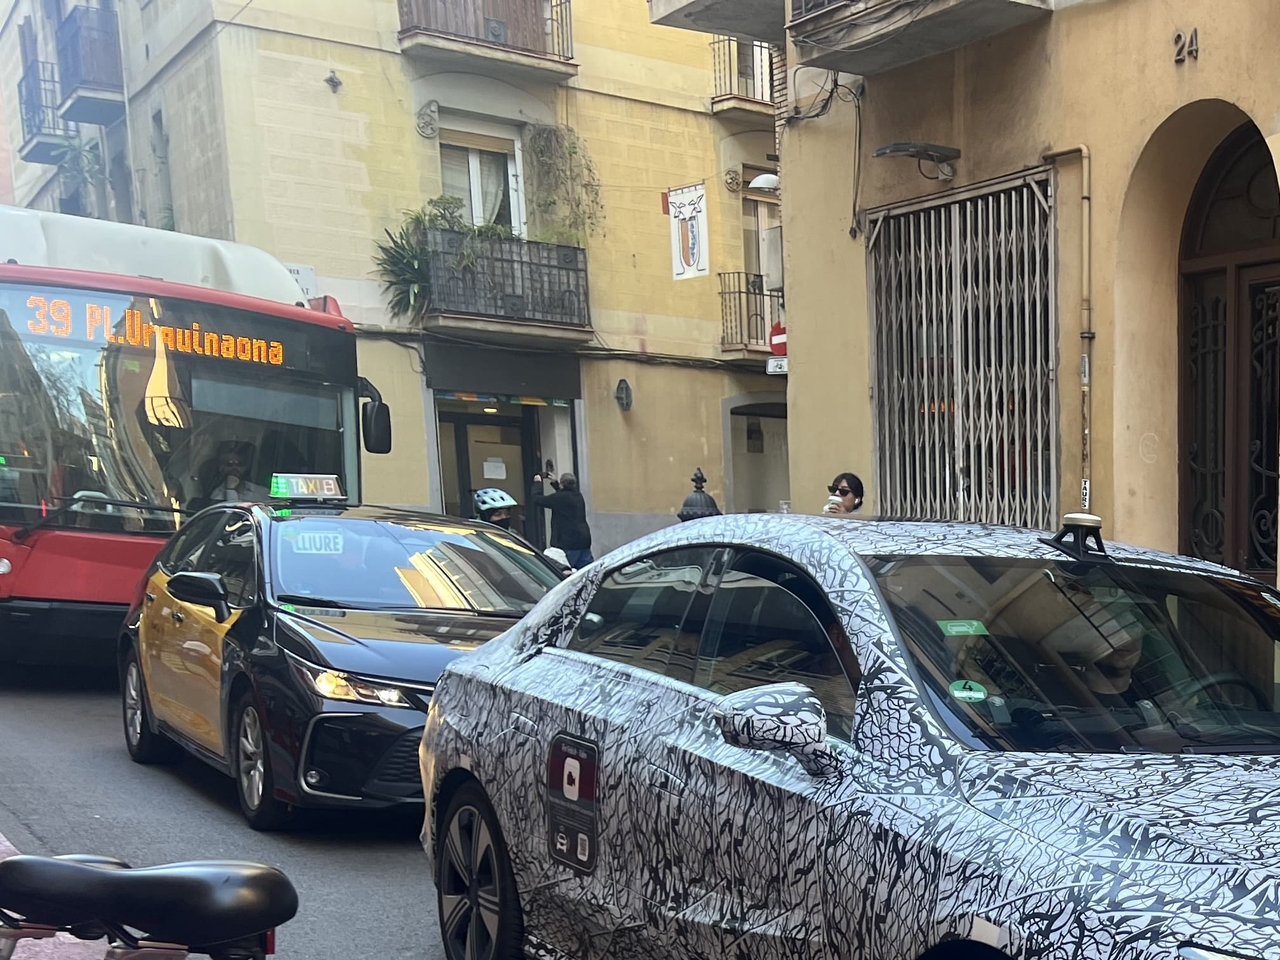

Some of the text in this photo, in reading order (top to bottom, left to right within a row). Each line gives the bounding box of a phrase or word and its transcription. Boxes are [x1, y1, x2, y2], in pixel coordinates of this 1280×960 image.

[1174, 27, 1199, 64] 24
[27, 295, 72, 337] 39
[290, 478, 320, 495] TAXI
[962, 680, 974, 692] 4
